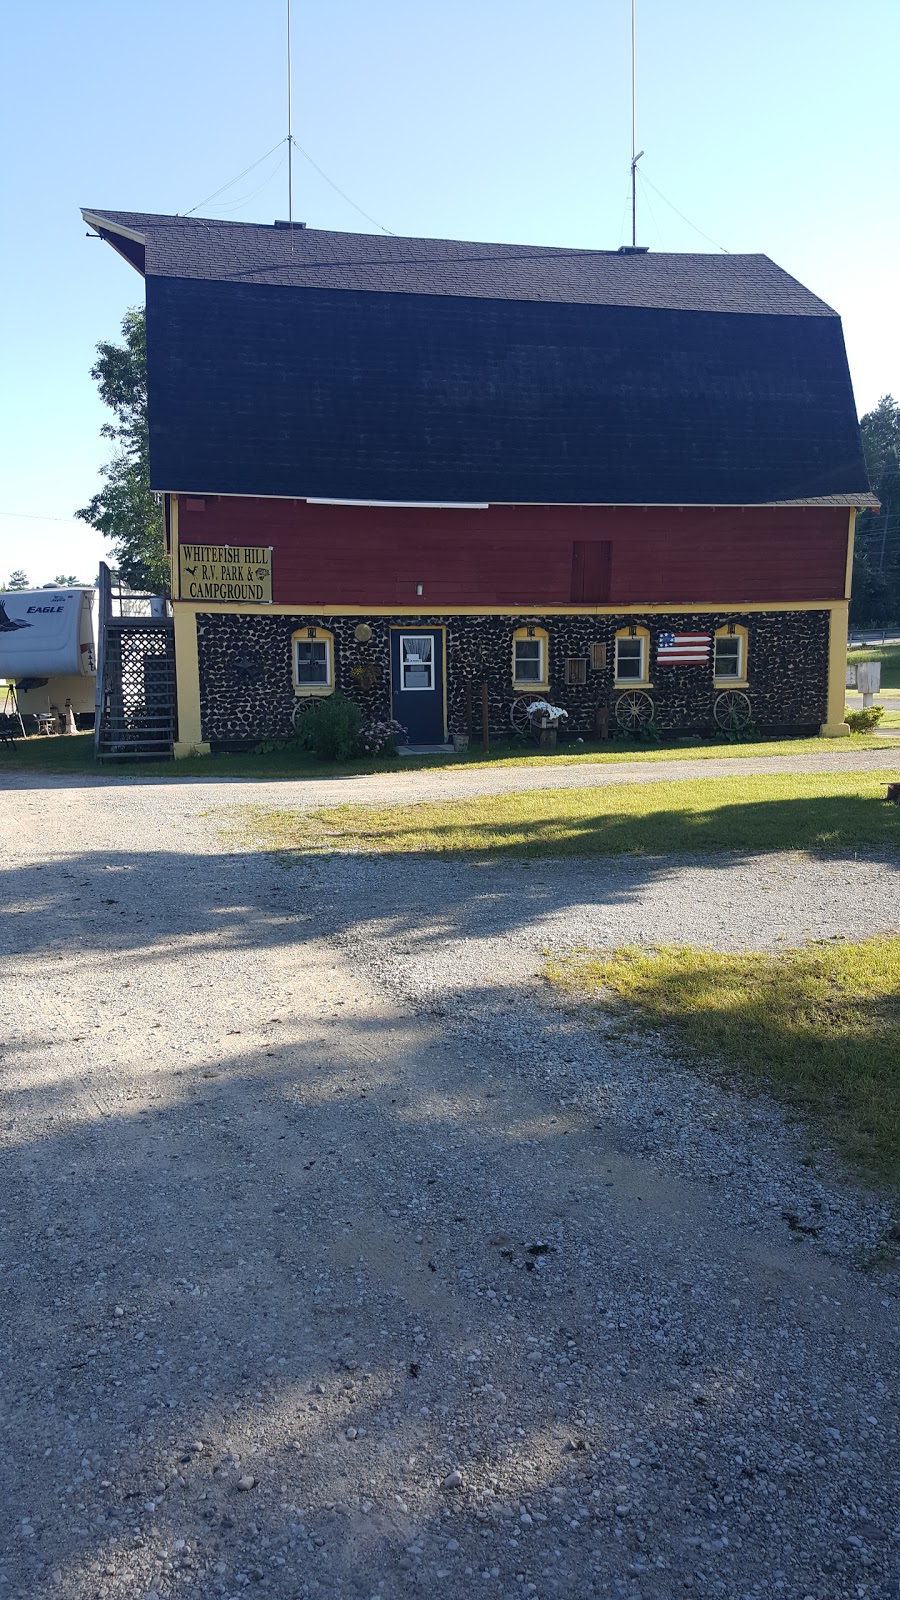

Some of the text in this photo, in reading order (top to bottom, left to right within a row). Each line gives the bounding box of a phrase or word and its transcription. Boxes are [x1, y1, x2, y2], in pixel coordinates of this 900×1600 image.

[183, 546, 268, 564] WHITEFISH HILL
[202, 565, 254, 582] R.V. PARK &
[189, 582, 263, 600] CAMPGROUND
[27, 606, 64, 614] EAGLE
